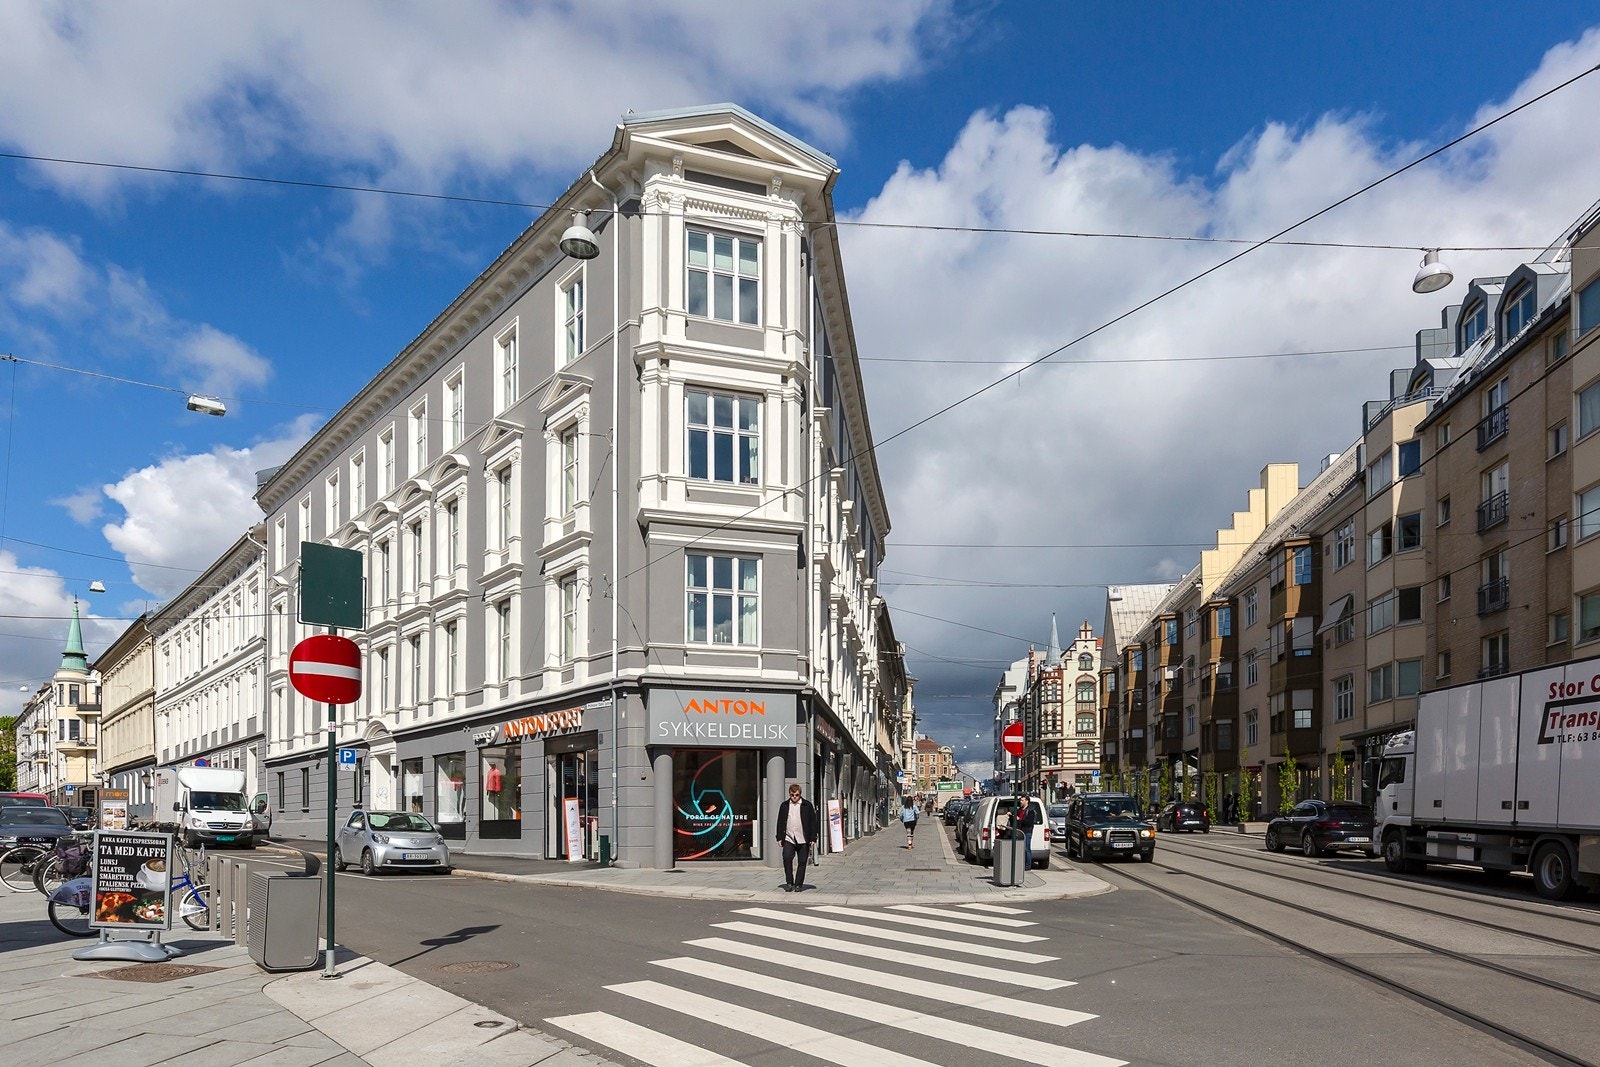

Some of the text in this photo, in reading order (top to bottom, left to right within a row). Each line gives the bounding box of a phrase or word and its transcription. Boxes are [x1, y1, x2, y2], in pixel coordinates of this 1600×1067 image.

[1549, 681, 1584, 700] Stor
[684, 698, 766, 717] ANTON
[658, 721, 789, 740] SYKKELDELISK
[1557, 733, 1575, 744] TLF:
[1577, 732, 1588, 742] 63
[343, 750, 352, 762] P
[133, 838, 165, 846] ESPRESSOBAR
[100, 845, 166, 858] TA MED KAFFE
[100, 858, 118, 866] LUNSJ
[99, 873, 134, 881] SMÅRETTER
[99, 880, 130, 888] ITALIENSK
